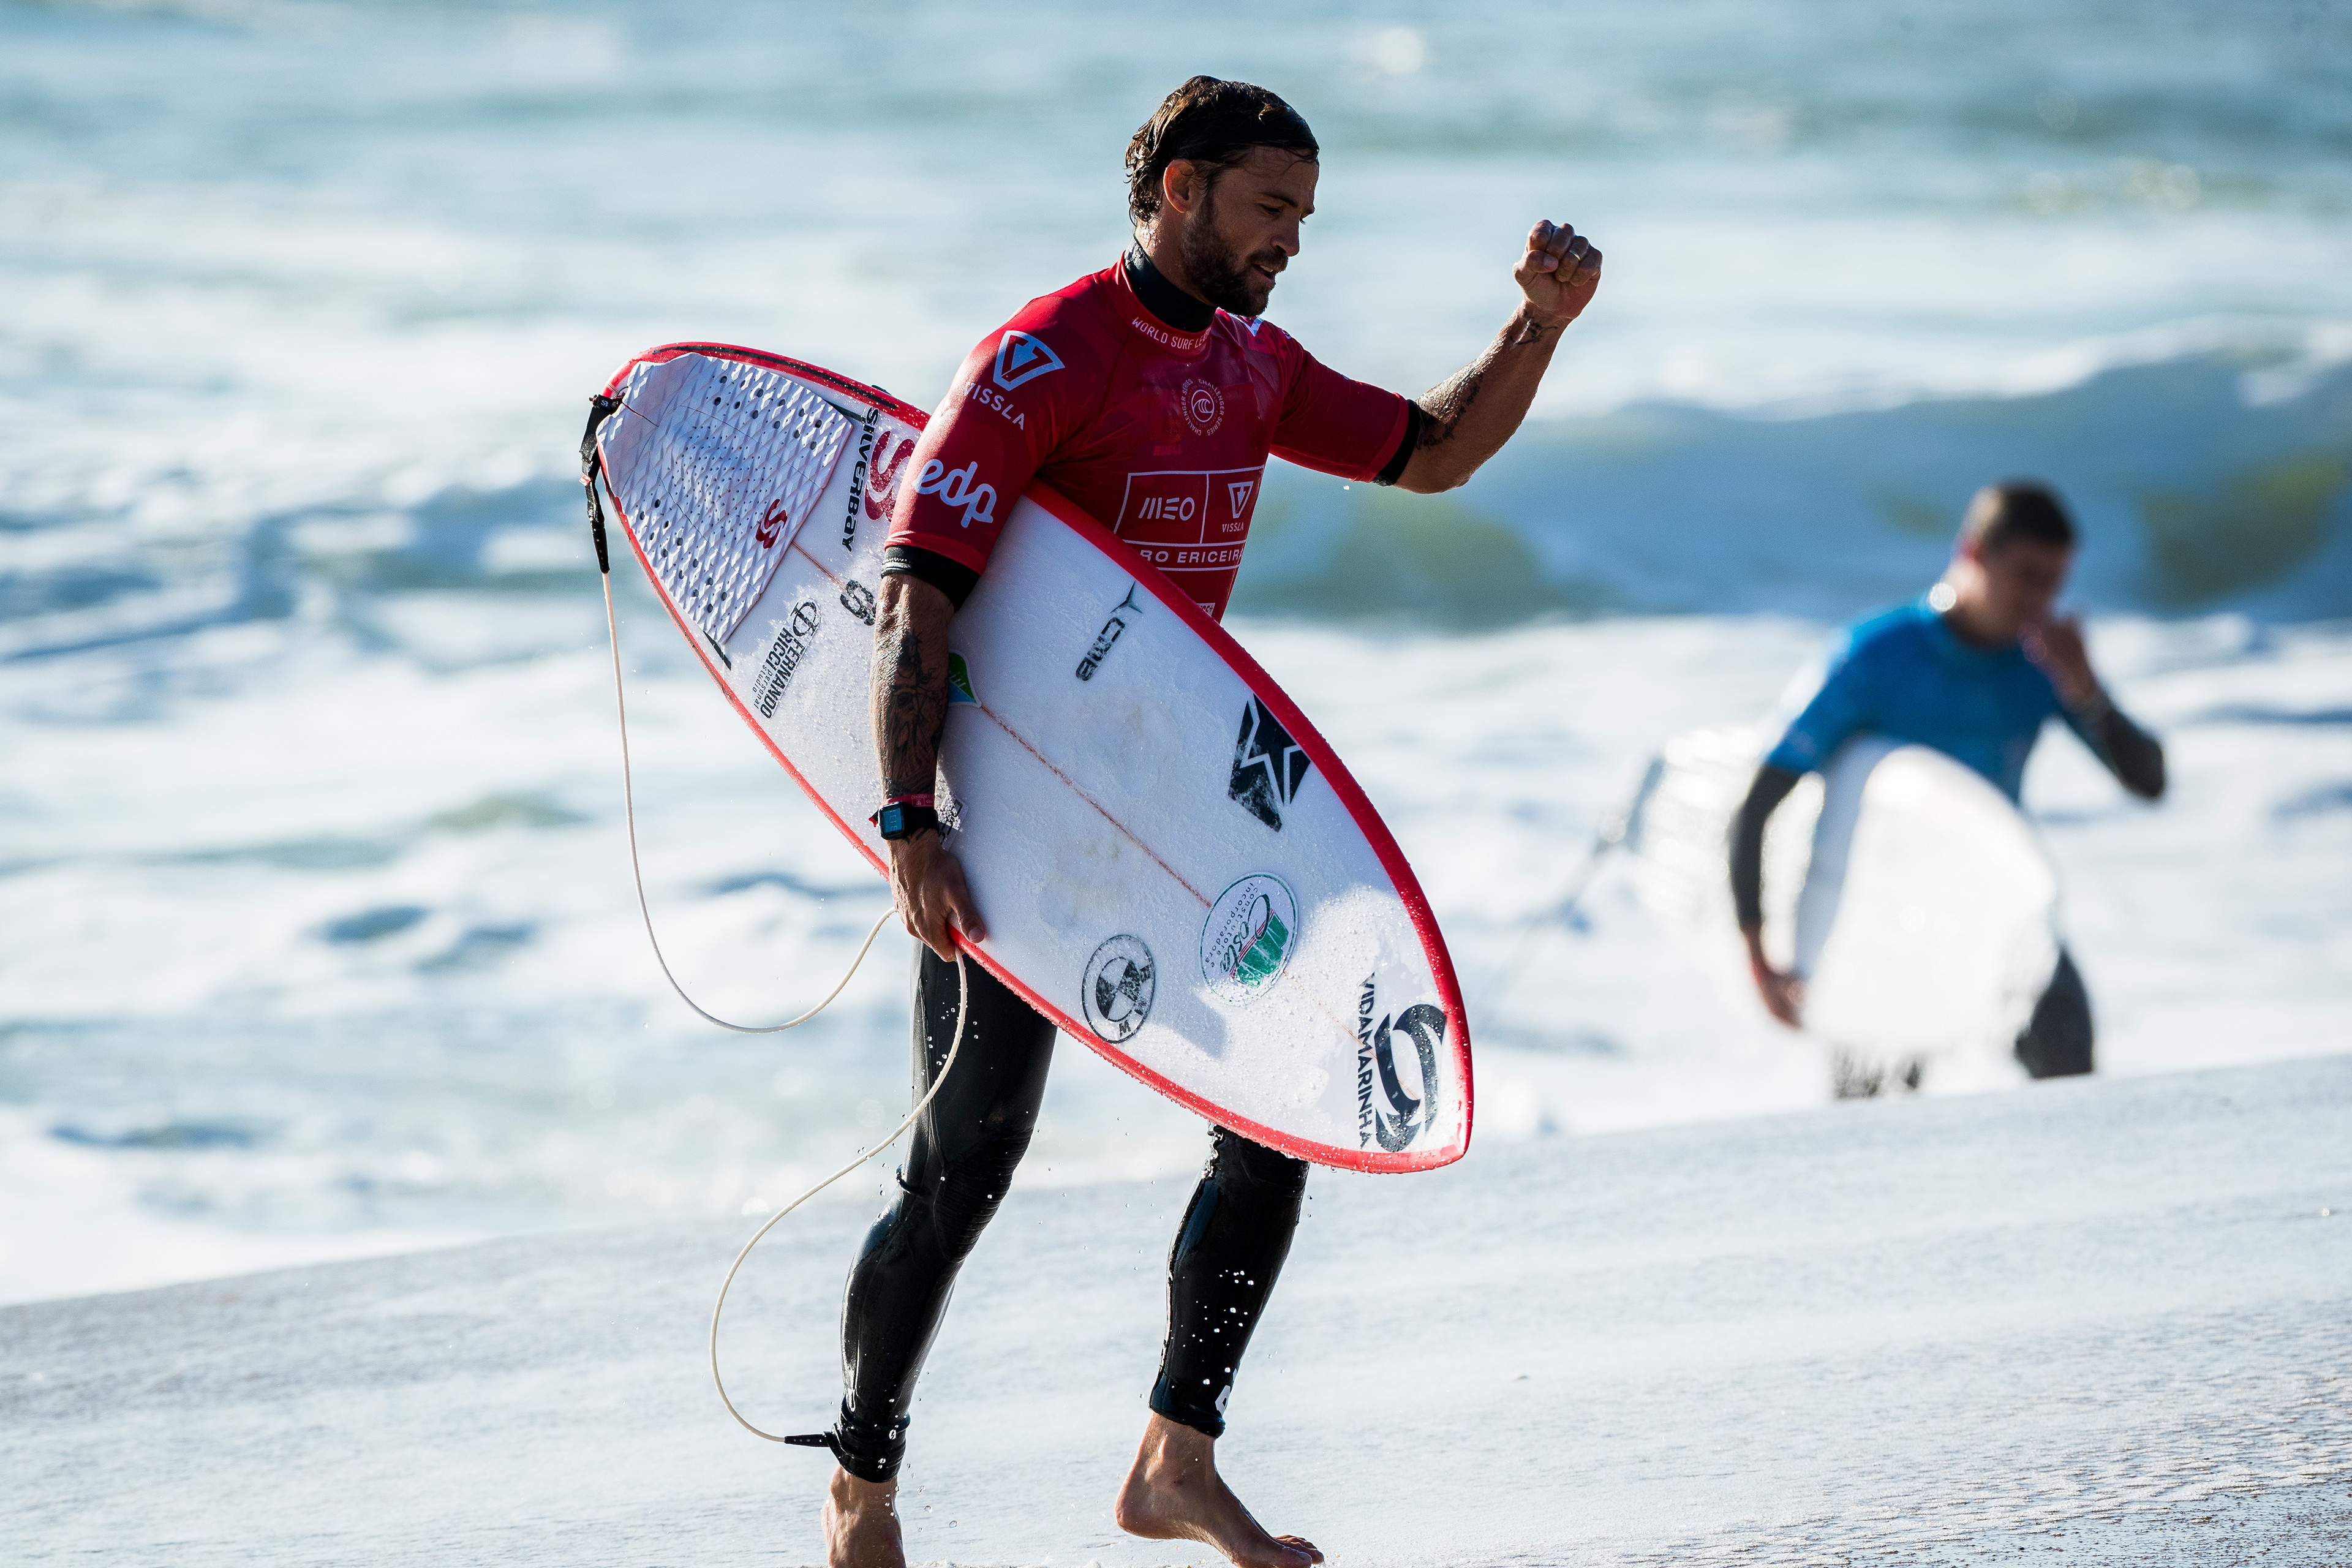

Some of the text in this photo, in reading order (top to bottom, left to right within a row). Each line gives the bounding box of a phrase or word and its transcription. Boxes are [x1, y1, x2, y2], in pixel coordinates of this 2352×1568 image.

[1132, 317, 1168, 343] WORLD
[1171, 336, 1194, 350] SURF
[964, 382, 1025, 431] VISSLA
[1182, 379, 1202, 435] CHALLENGER SERIES
[1198, 379, 1224, 415] CHALLENGER
[1207, 417, 1223, 435] SERIES
[912, 459, 997, 529] edp
[1138, 497, 1194, 521] MEO
[1222, 522, 1244, 532] VISSLA
[766, 627, 793, 671] RICCI
[752, 665, 767, 693] studio
[753, 669, 773, 709] personal
[760, 638, 805, 718] FERNANDO
[1205, 882, 1255, 963] incorporadora
[1216, 887, 1259, 956] construtora
